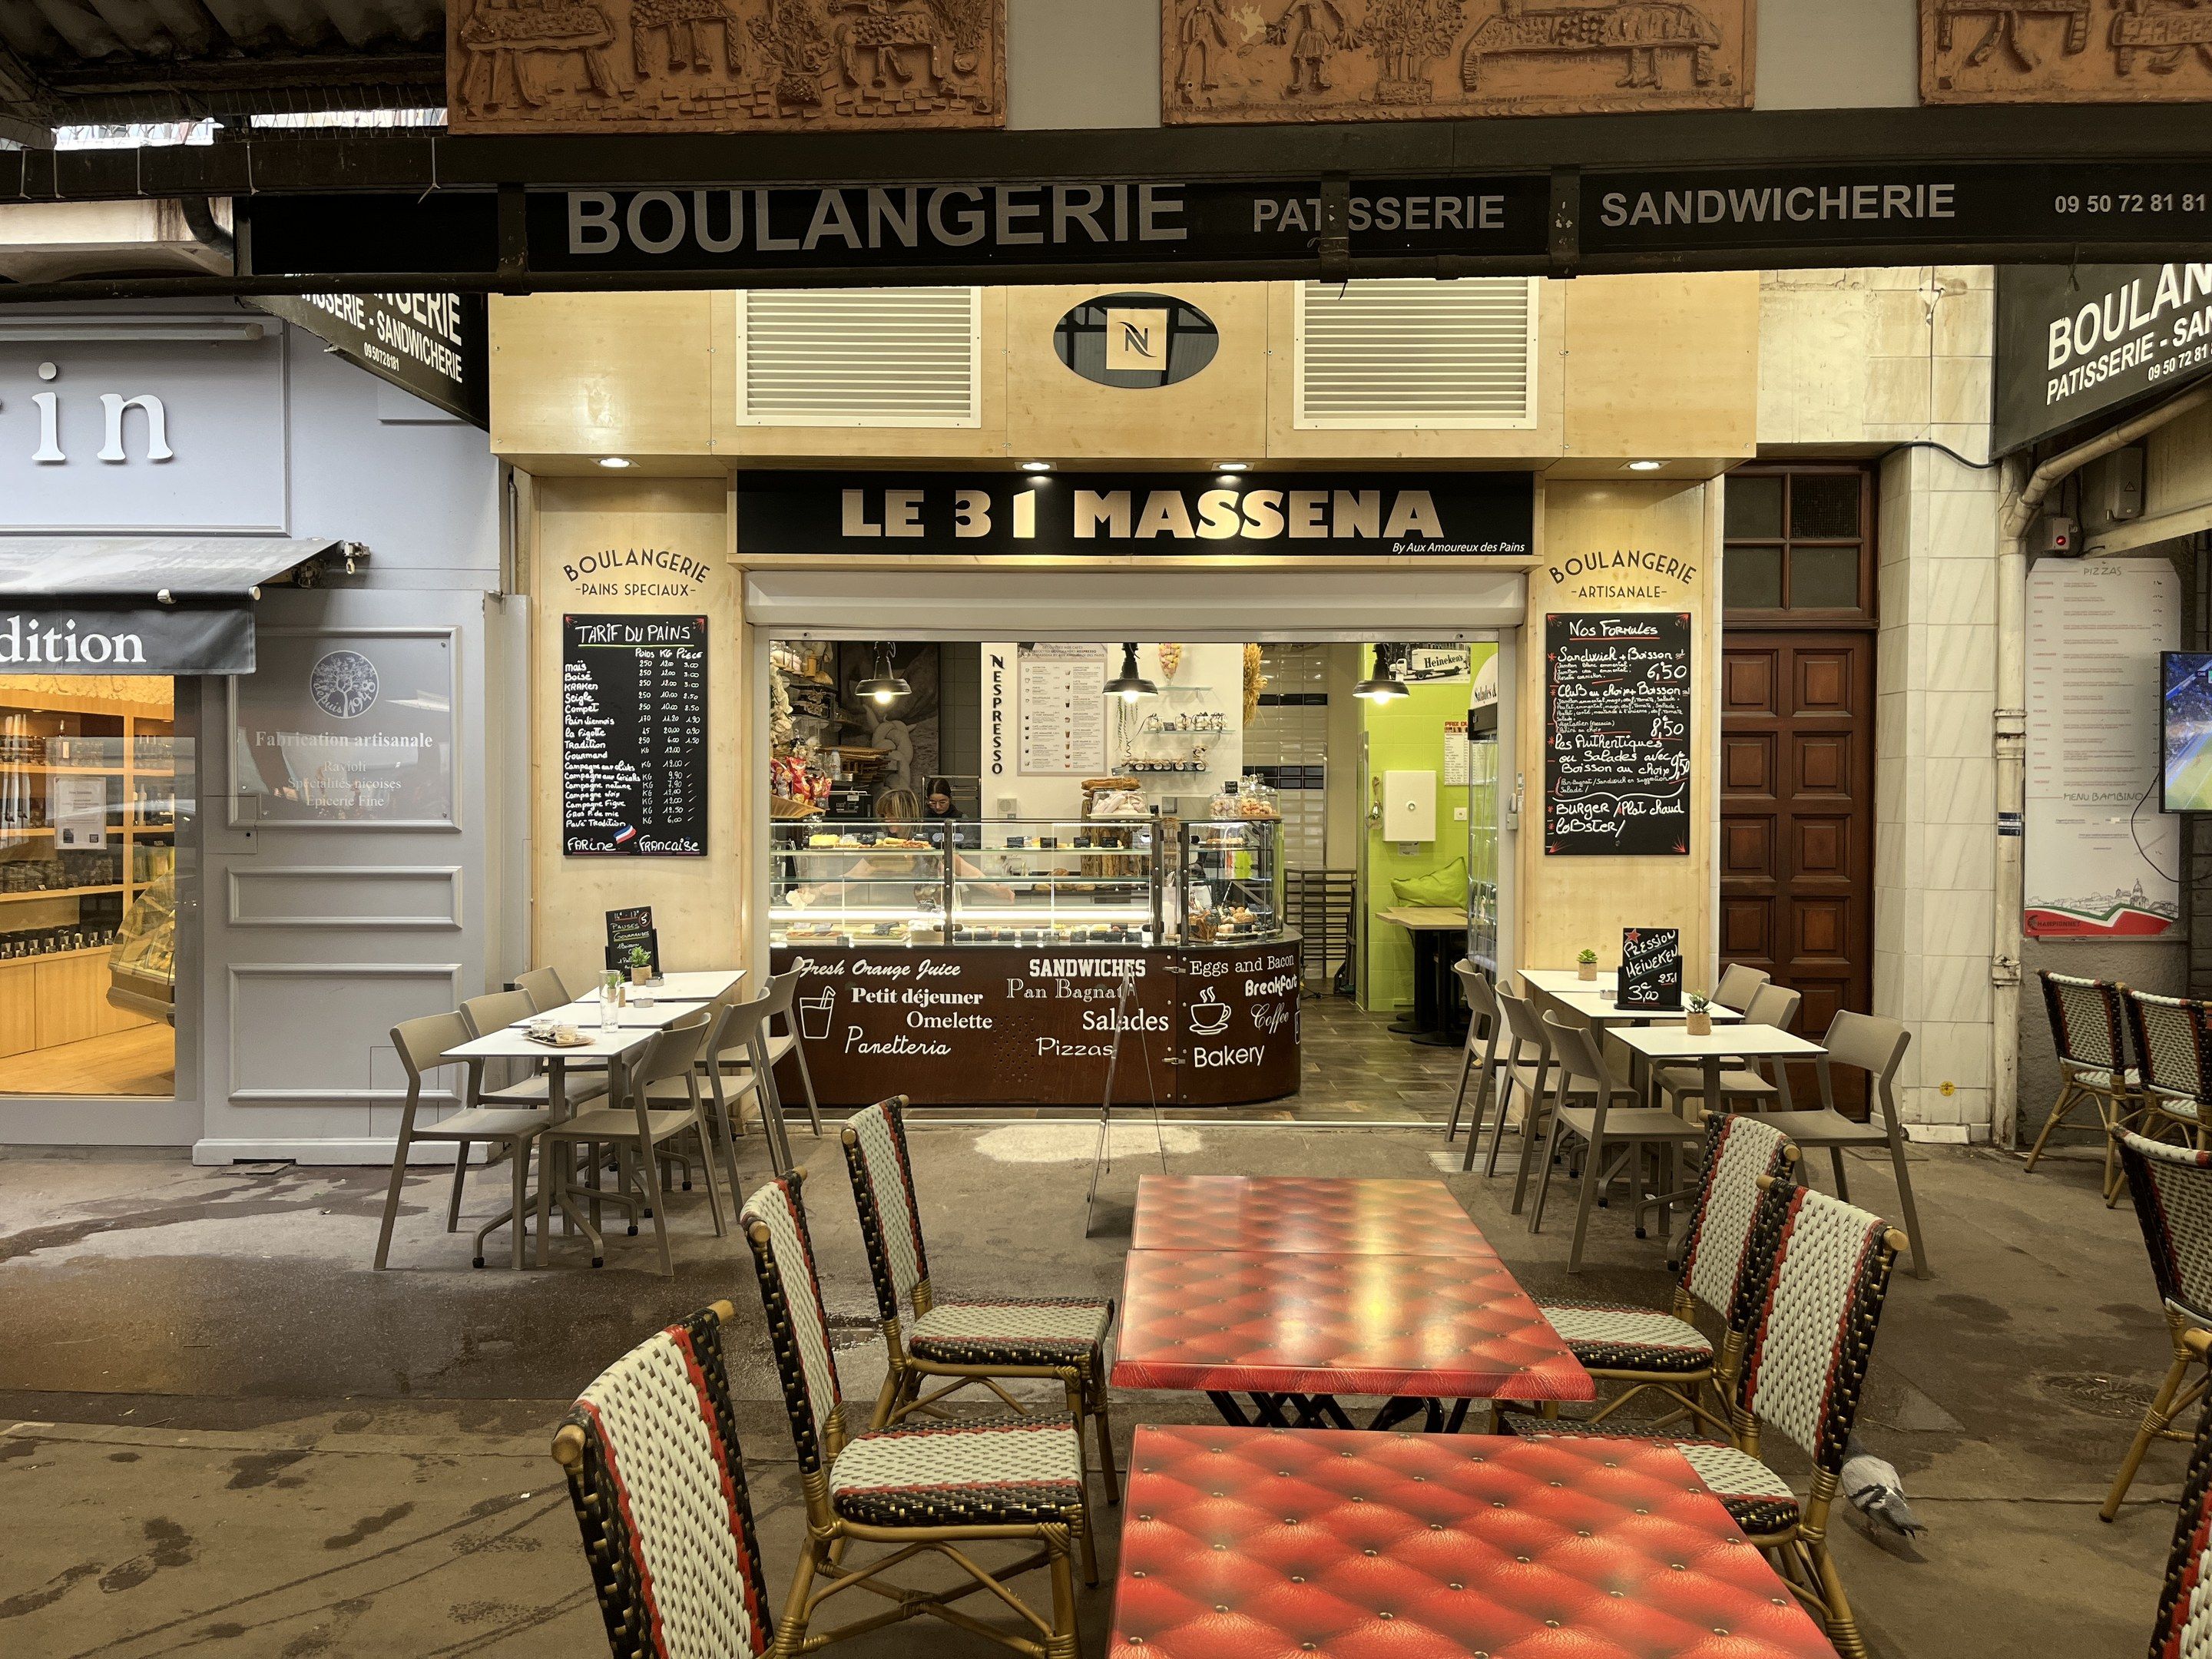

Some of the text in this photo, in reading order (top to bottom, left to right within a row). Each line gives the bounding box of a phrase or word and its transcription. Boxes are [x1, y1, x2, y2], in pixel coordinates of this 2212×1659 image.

[1253, 195, 1505, 232] PATSSERIE
[1600, 184, 1956, 227] SANDWICHERIE
[2055, 194, 2205, 213] 09 50 72 81 81
[568, 183, 1187, 254] BOULANGERIE
[376, 310, 462, 383] SANDWICHERIE
[2047, 332, 2154, 406] PATISSERIE
[2148, 343, 2207, 381] 09 50 72 81
[0, 362, 174, 461] in
[841, 489, 923, 537] LE
[1074, 489, 1444, 538] MASSENA
[1392, 542, 1525, 554] By Aux Amoureux des Pains
[563, 548, 710, 583] BOULANGERIE
[1548, 550, 1697, 584] BOULANGERIE
[2084, 567, 2121, 575] PIZZAS
[0, 615, 147, 664] dition
[625, 625, 644, 642] DU
[1569, 619, 1596, 637] Nos
[313, 680, 376, 714] depuis 1948
[990, 654, 1005, 774] NESPRESSO
[256, 731, 432, 747] Fabrication artisanale
[324, 760, 366, 773] Ravioli
[1561, 763, 1611, 773] Boisson
[288, 777, 402, 791] Spécialités niçoises
[359, 796, 384, 806] Fine
[2064, 793, 2144, 802] MENU BAMBINO
[800, 959, 960, 981] Fresh Orange Juice
[1029, 959, 1146, 977] SANDWICHES
[1190, 953, 1295, 977] Eggs and Bacon
[1006, 978, 1124, 1002] Pan Bagnat
[1245, 973, 1297, 997] Breakfast
[851, 987, 983, 1008] Petit déjeuner
[906, 1011, 992, 1029] Omelette
[1083, 1008, 1169, 1031] Salades
[1251, 1002, 1289, 1035] Coffee
[845, 1025, 952, 1055] Panetteria
[1036, 1037, 1114, 1057] Pizzas
[1194, 1045, 1265, 1068] Bakery
